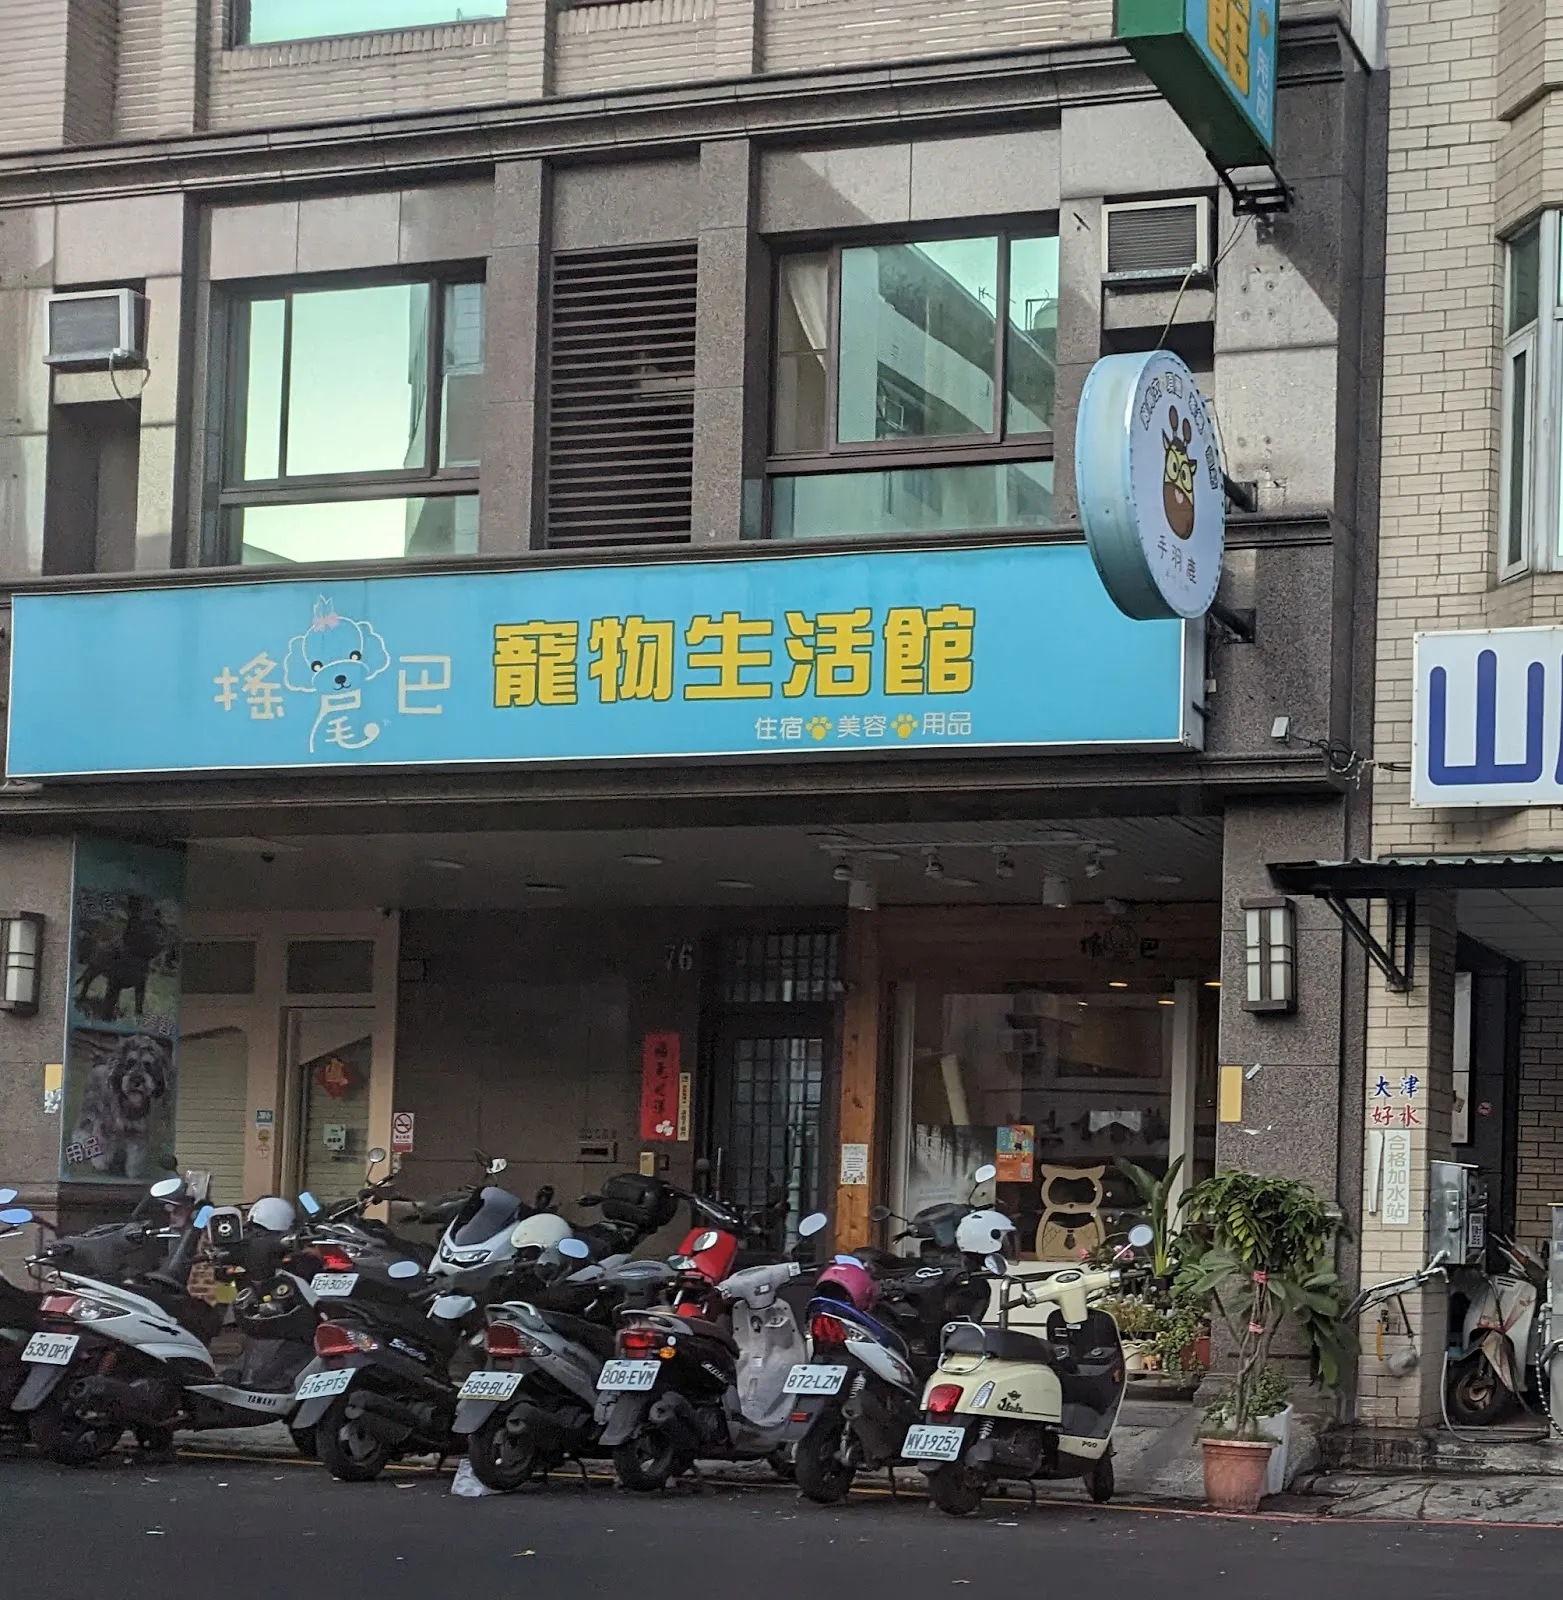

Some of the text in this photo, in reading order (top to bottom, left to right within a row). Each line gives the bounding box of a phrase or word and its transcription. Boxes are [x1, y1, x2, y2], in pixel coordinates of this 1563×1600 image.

[1157, 535, 1197, 585] 手羽鹿
[493, 604, 977, 708] 寵物生活館
[754, 711, 972, 741] 住宿 美容 用品
[1428, 649, 1563, 786] 山
[1374, 1075, 1420, 1099] 大津
[1372, 1105, 1422, 1128] 好水
[66, 1136, 102, 1165] 用品
[1387, 1134, 1406, 1219] 合格加水站
